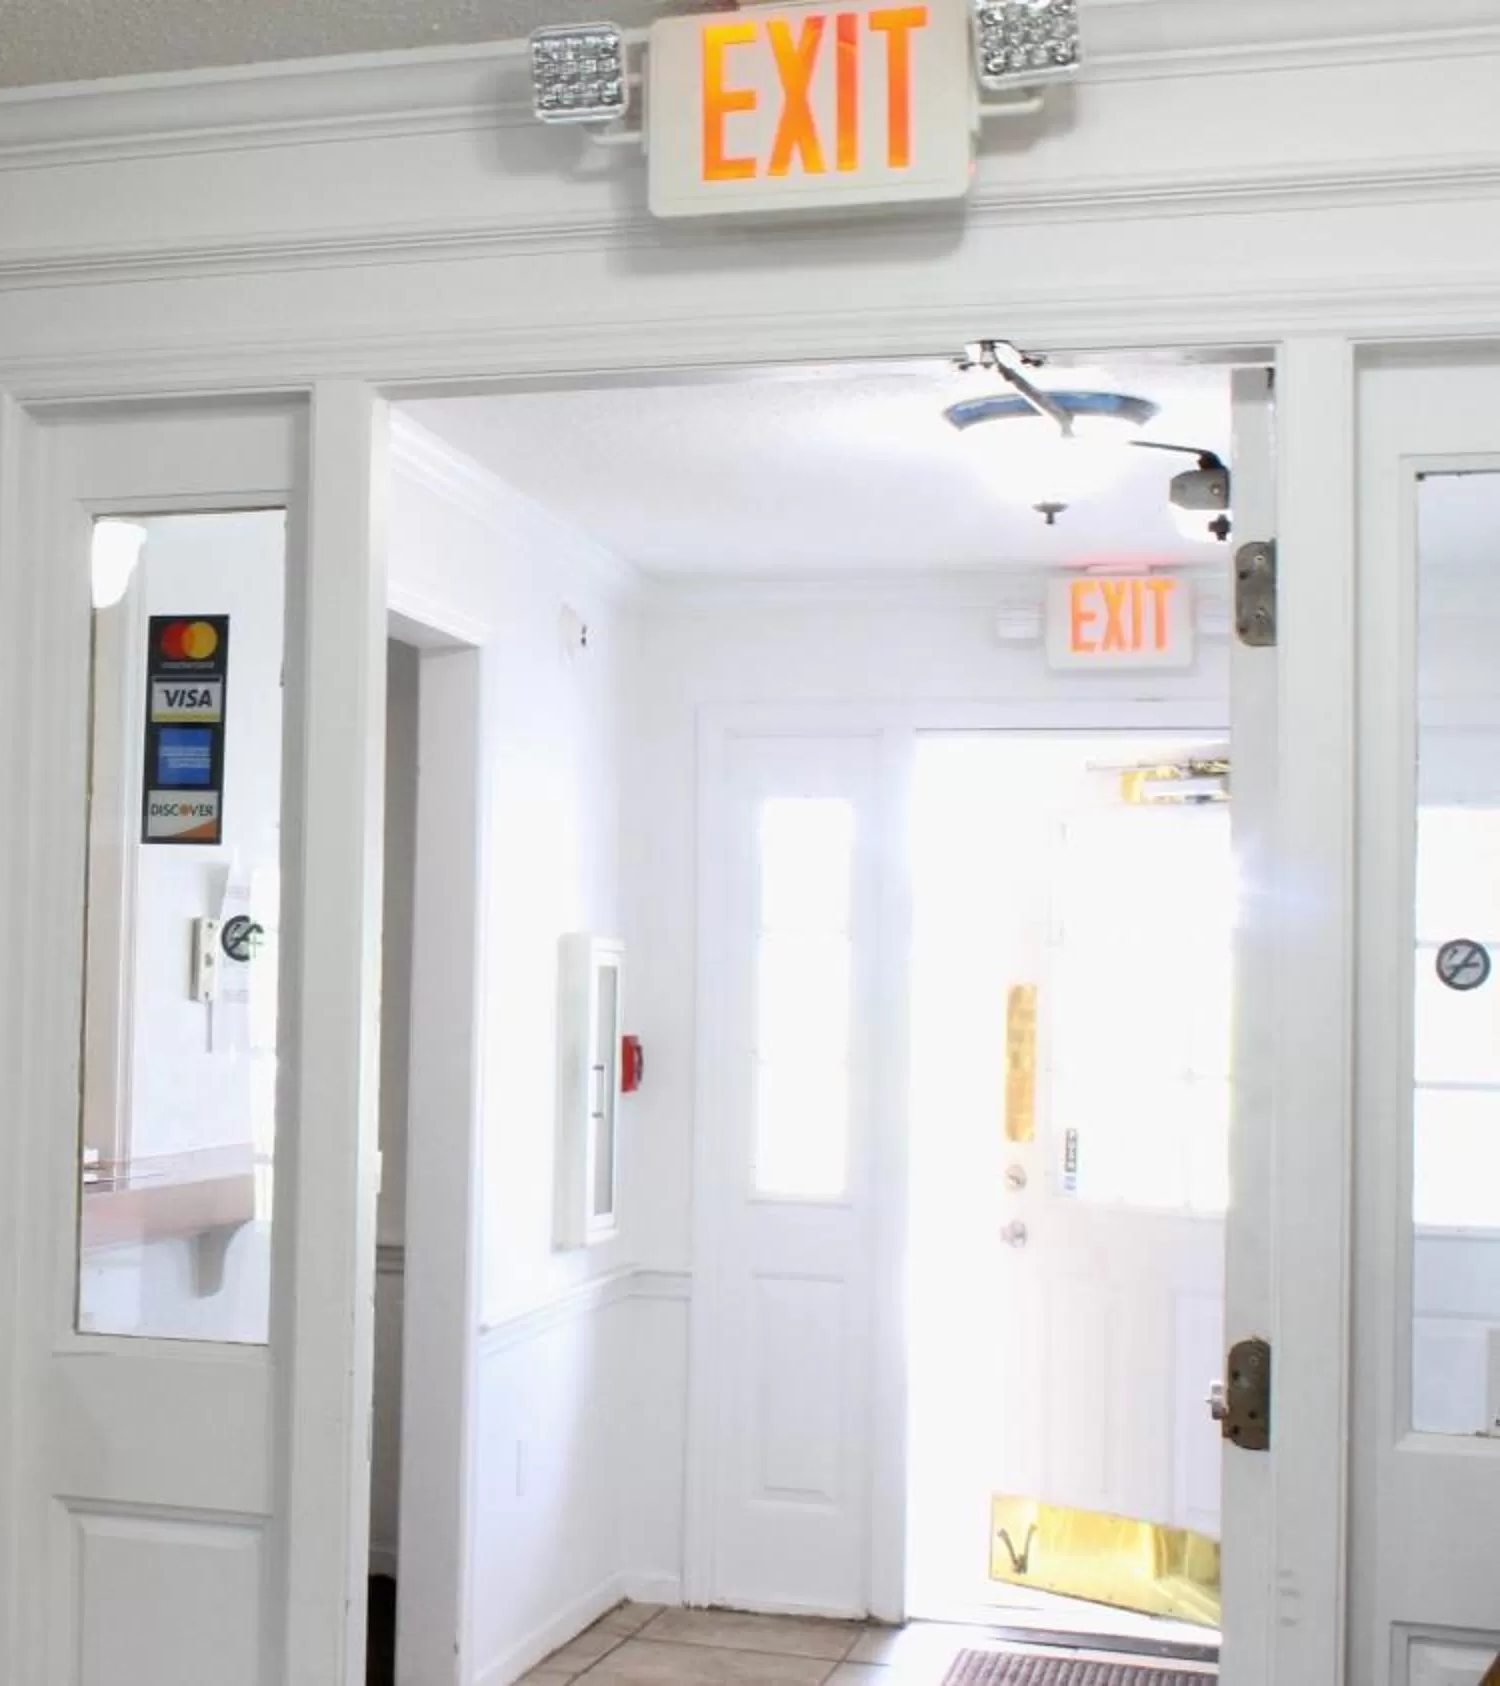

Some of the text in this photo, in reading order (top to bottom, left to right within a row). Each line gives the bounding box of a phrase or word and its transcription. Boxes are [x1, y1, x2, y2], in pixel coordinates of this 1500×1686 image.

[702, 5, 927, 181] EXIT
[1070, 577, 1177, 652] EXIT
[163, 689, 213, 708] VISA
[150, 803, 213, 817] DISCOVER
